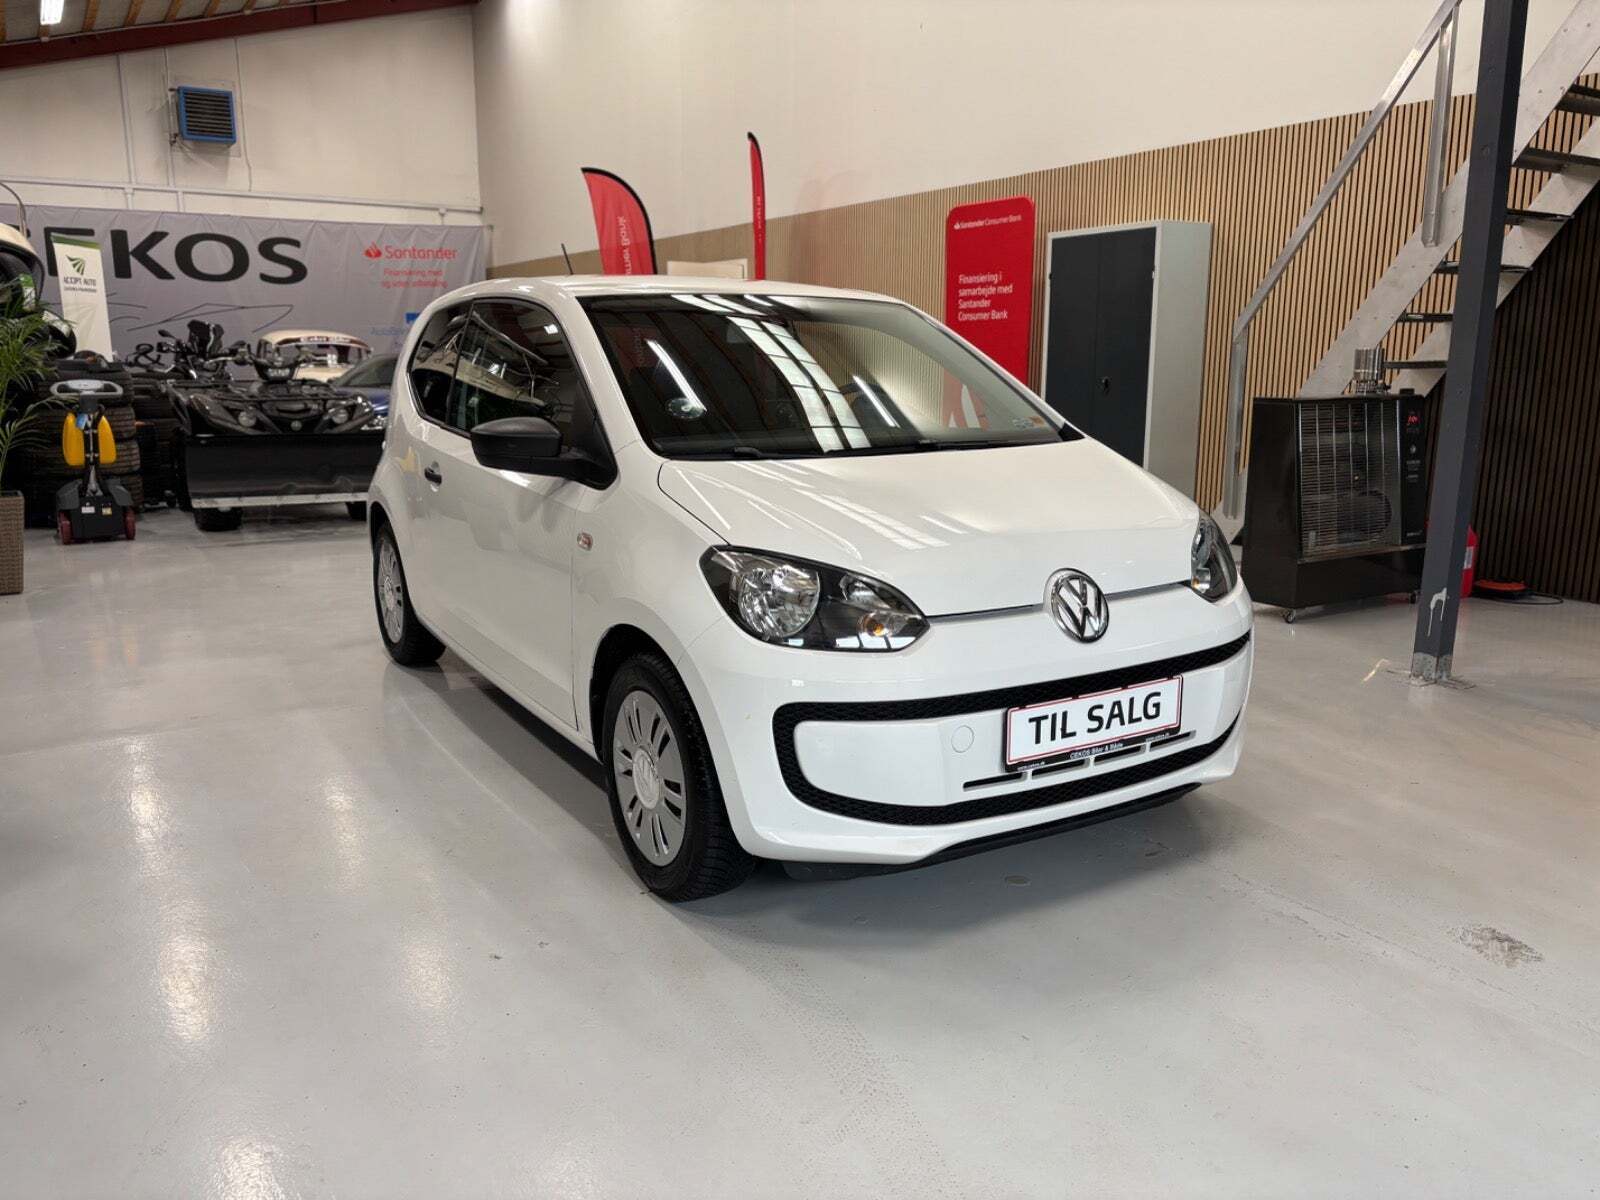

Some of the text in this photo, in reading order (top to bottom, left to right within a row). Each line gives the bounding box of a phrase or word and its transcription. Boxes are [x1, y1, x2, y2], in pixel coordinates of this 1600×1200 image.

[384, 245, 458, 259] Santander
[959, 272, 998, 284] Finansiering
[959, 284, 1013, 297] samarbejde med
[959, 298, 991, 309] Santander
[959, 309, 1008, 321] Consumer Bank
[1028, 691, 1161, 745] TIL SALG
